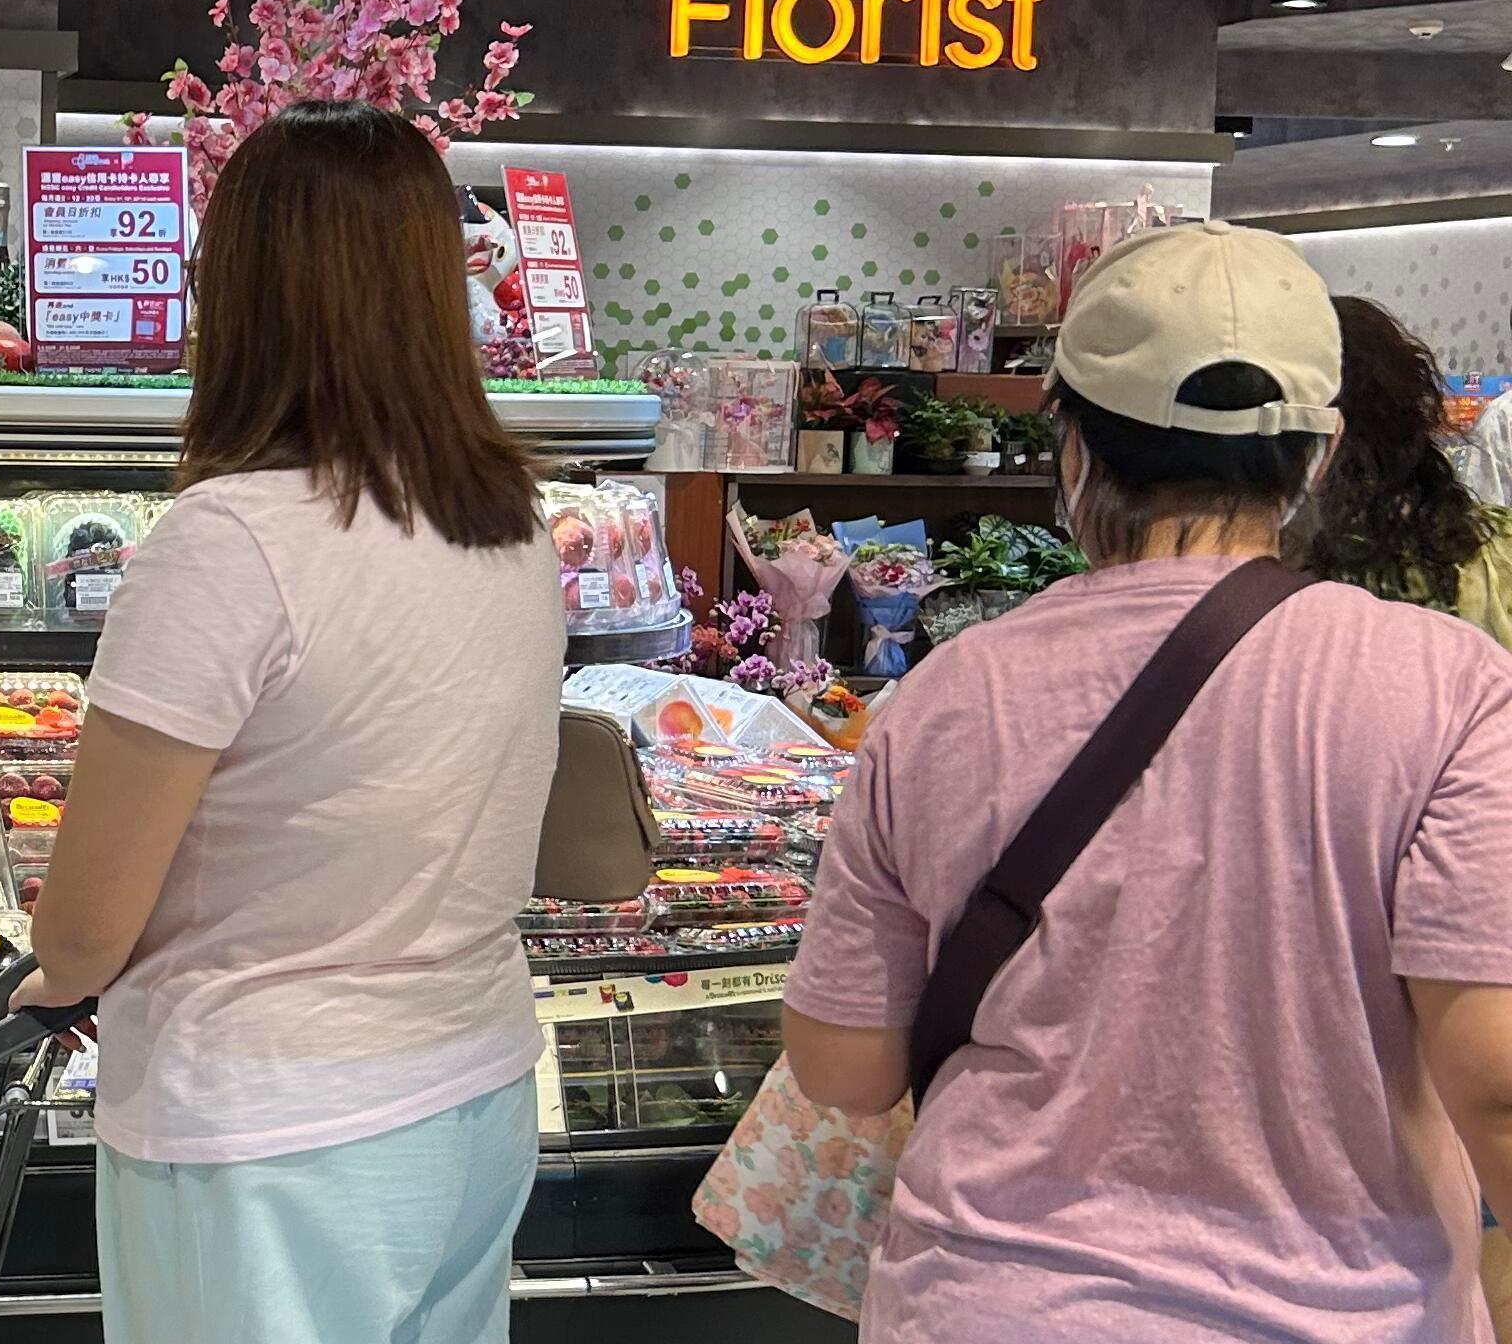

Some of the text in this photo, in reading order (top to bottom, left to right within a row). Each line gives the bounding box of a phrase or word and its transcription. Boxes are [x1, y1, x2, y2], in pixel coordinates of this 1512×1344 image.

[44, 206, 102, 218] 會員日折扣
[753, 972, 787, 986] Drisc
